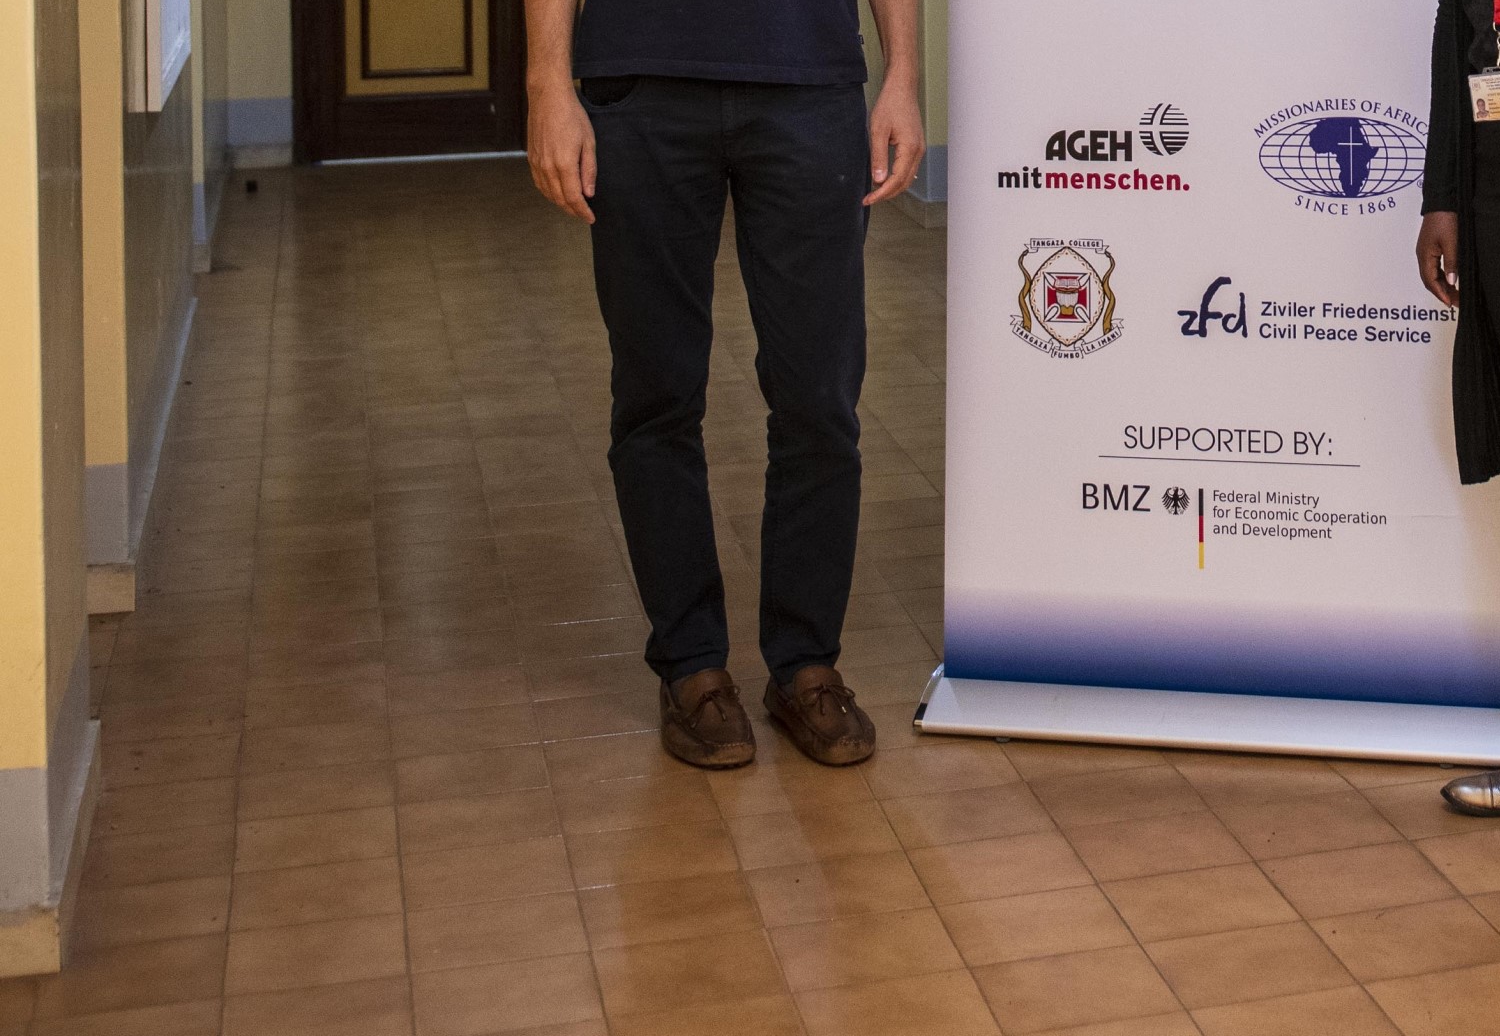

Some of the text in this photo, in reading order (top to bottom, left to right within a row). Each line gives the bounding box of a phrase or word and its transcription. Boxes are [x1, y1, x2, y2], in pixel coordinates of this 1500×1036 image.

[1253, 98, 1429, 138] MISSIONARIES OF AFRIC
[1045, 129, 1132, 162] AGEH
[998, 166, 1190, 192] mitmenschen.
[1294, 194, 1397, 216] SINCE 1868
[1032, 239, 1100, 248] TANGAZA COLLEGE
[1260, 301, 1457, 322] Ziviler Friedensdienst
[1015, 326, 1120, 359] TANGAZA FUMBO LA IMANI
[1258, 323, 1432, 344] Civil Peace Service
[1123, 425, 1333, 456] SUPPORTED BY:
[1082, 482, 1151, 512] BMZ
[1212, 490, 1320, 509] Federal Ministry
[1212, 505, 1388, 526] for Economic Cooperation
[1212, 523, 1332, 541] and Development
